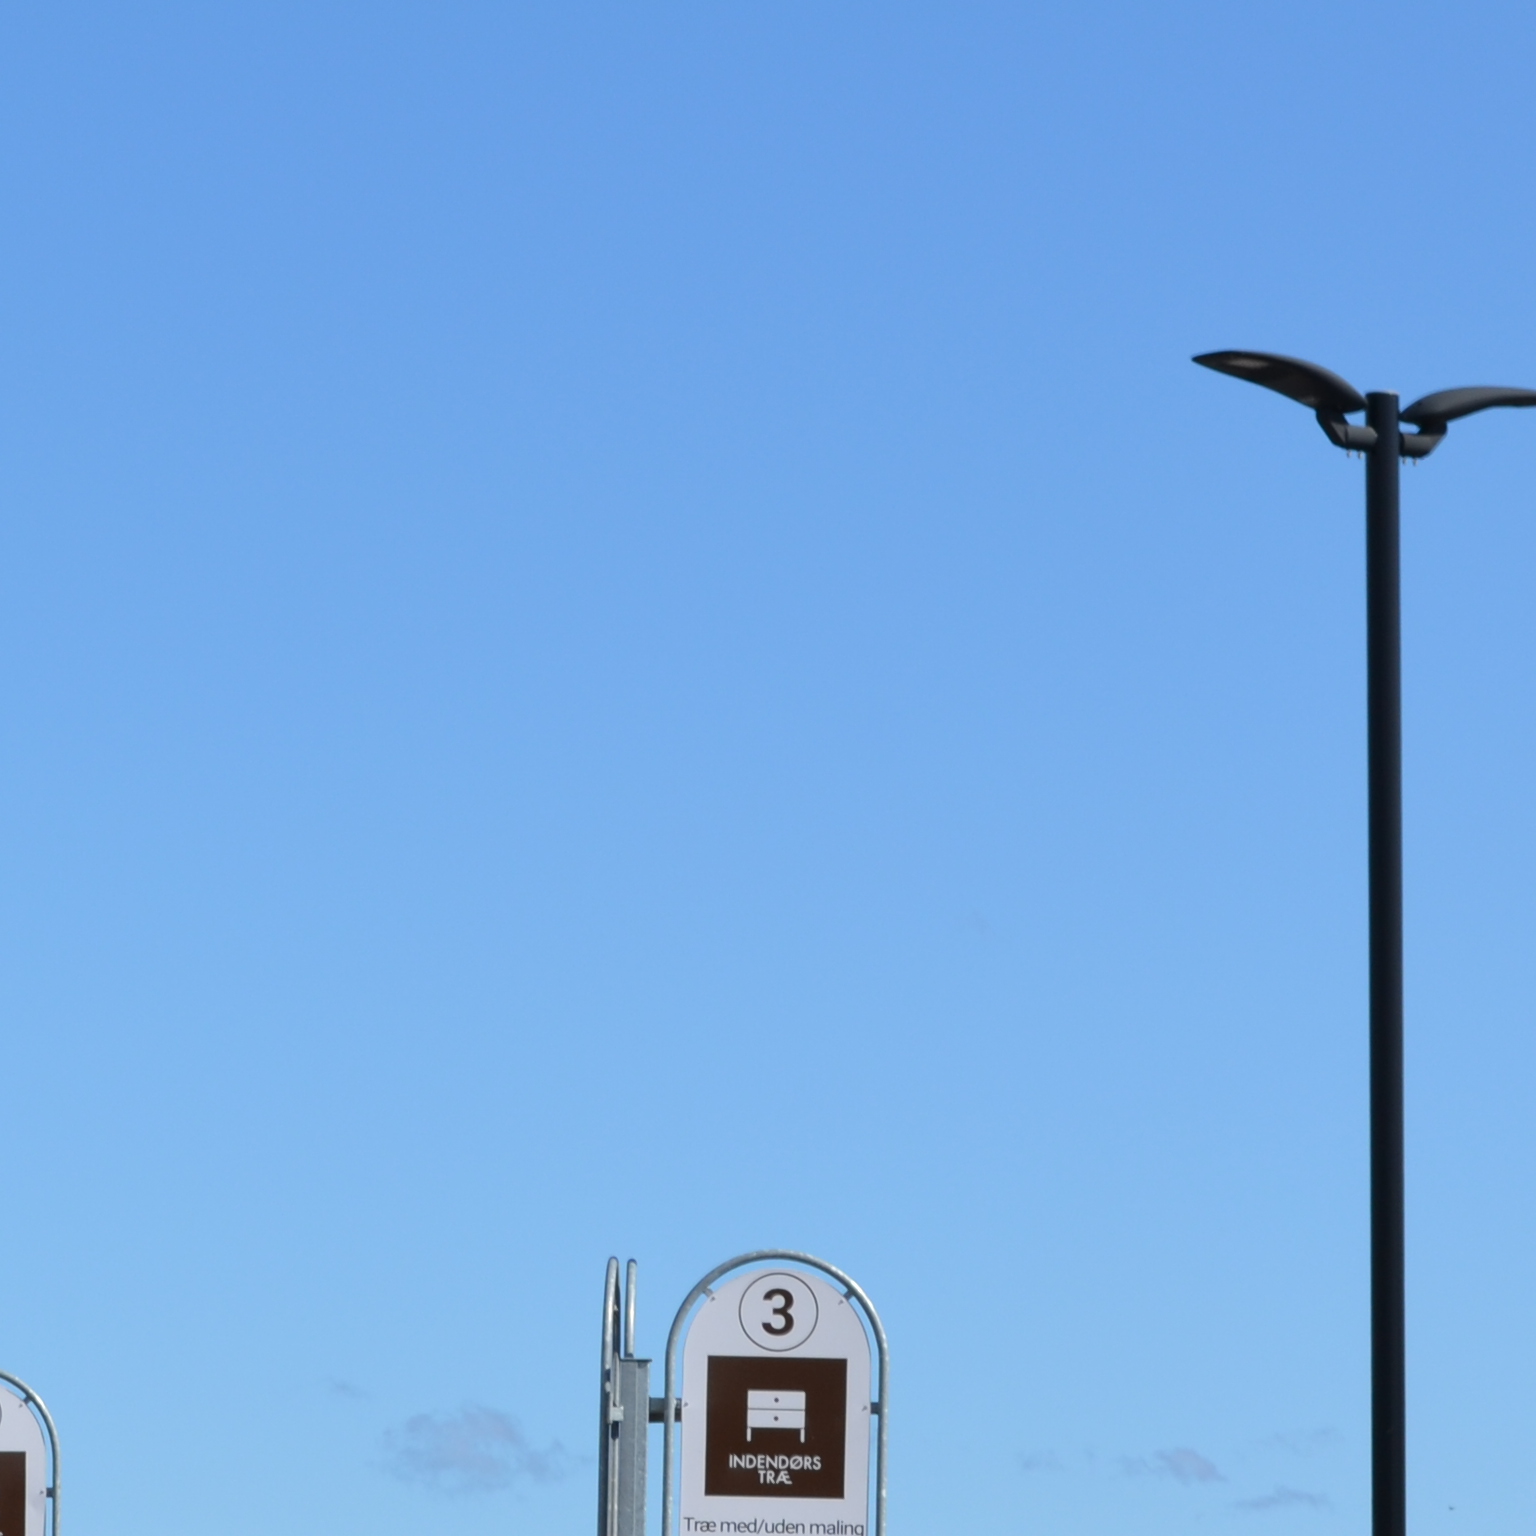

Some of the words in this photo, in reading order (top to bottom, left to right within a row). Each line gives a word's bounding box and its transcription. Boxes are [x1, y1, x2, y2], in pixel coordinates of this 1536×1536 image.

[762, 1288, 794, 1336] 3
[729, 1454, 822, 1470] INDENDØRS
[758, 1470, 792, 1485] TRÆ
[683, 1517, 716, 1532] Træ
[720, 1518, 805, 1535] med/uden
